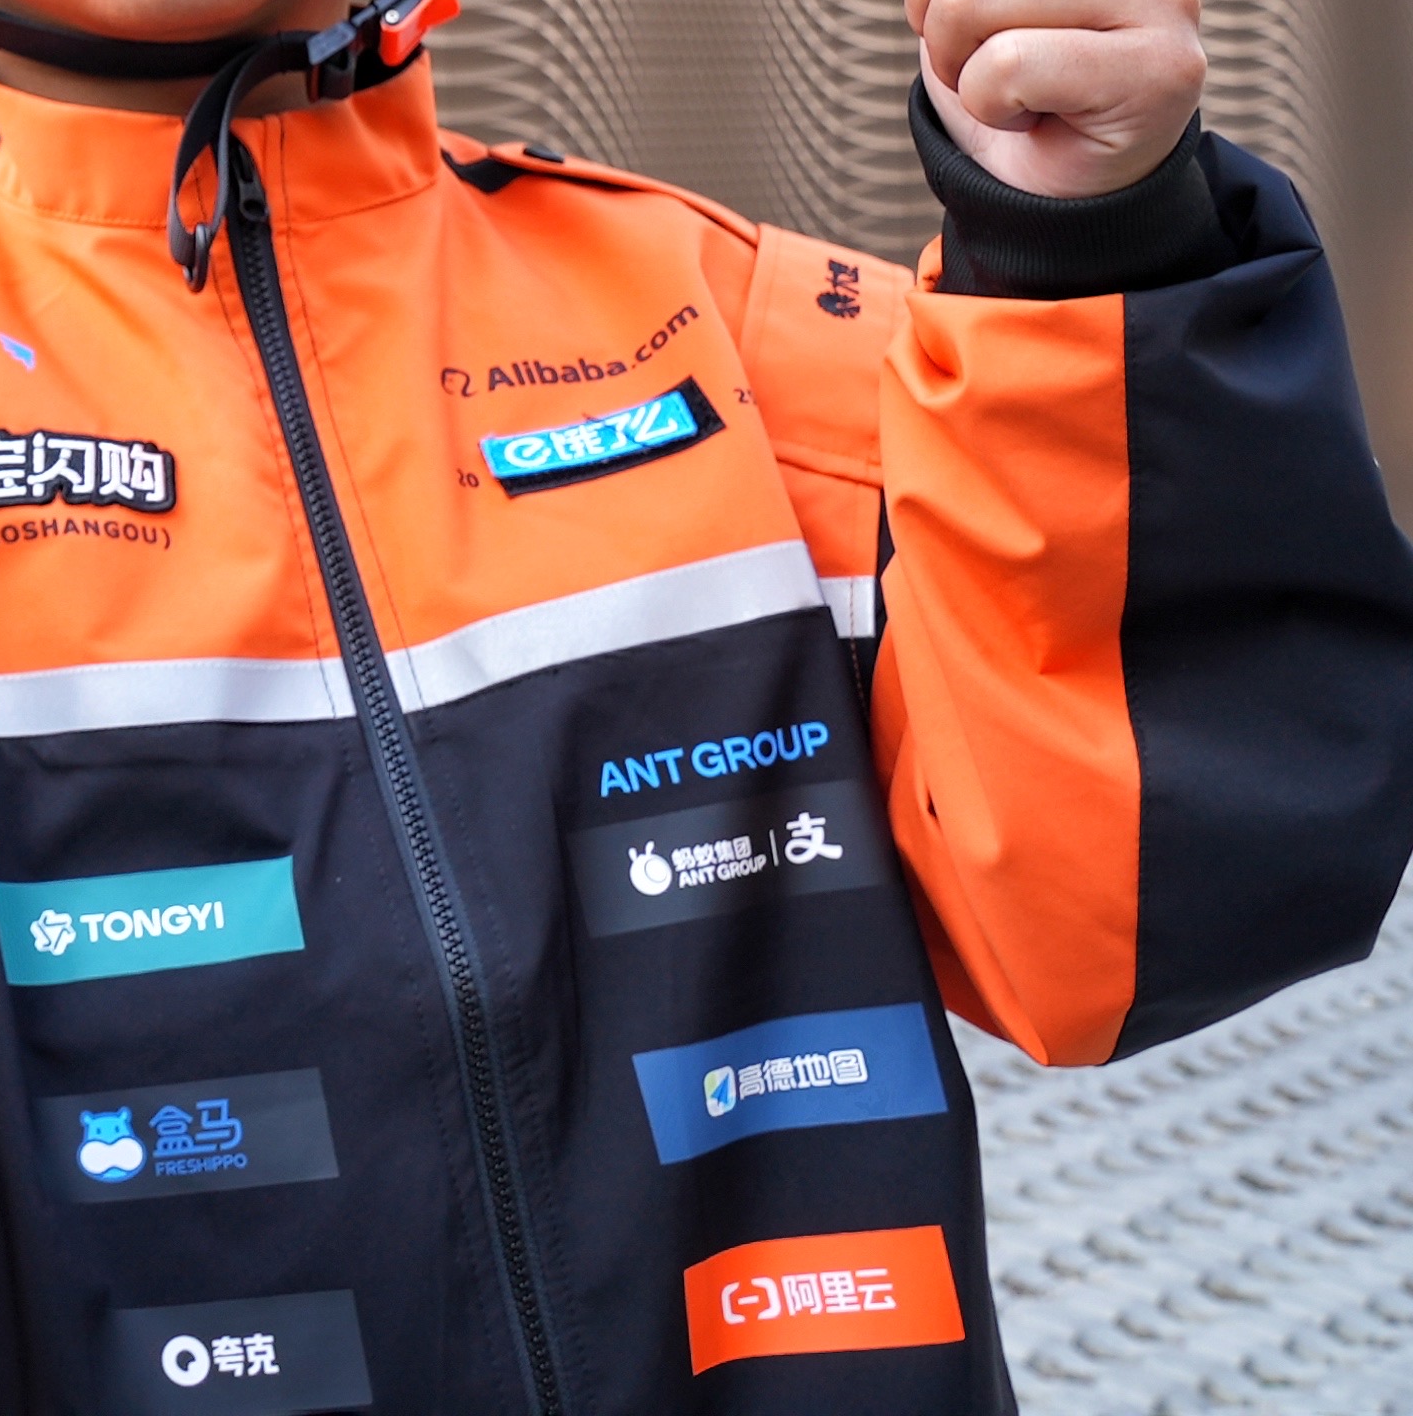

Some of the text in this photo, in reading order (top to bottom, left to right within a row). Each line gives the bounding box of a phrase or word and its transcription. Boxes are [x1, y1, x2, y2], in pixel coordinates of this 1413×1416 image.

[487, 302, 699, 392] Alibaba.com
[600, 721, 829, 798] ANT GROUP
[671, 835, 752, 872] 蚂蚁集团
[678, 854, 767, 889] ANT GROUP
[79, 901, 225, 943] TONGYI
[738, 1048, 869, 1100] 高德地图
[148, 1097, 245, 1158] 盒马
[155, 1152, 248, 1177] FRESHIPPO
[781, 1267, 897, 1316] 阿里云
[211, 1332, 280, 1378] 夸克
